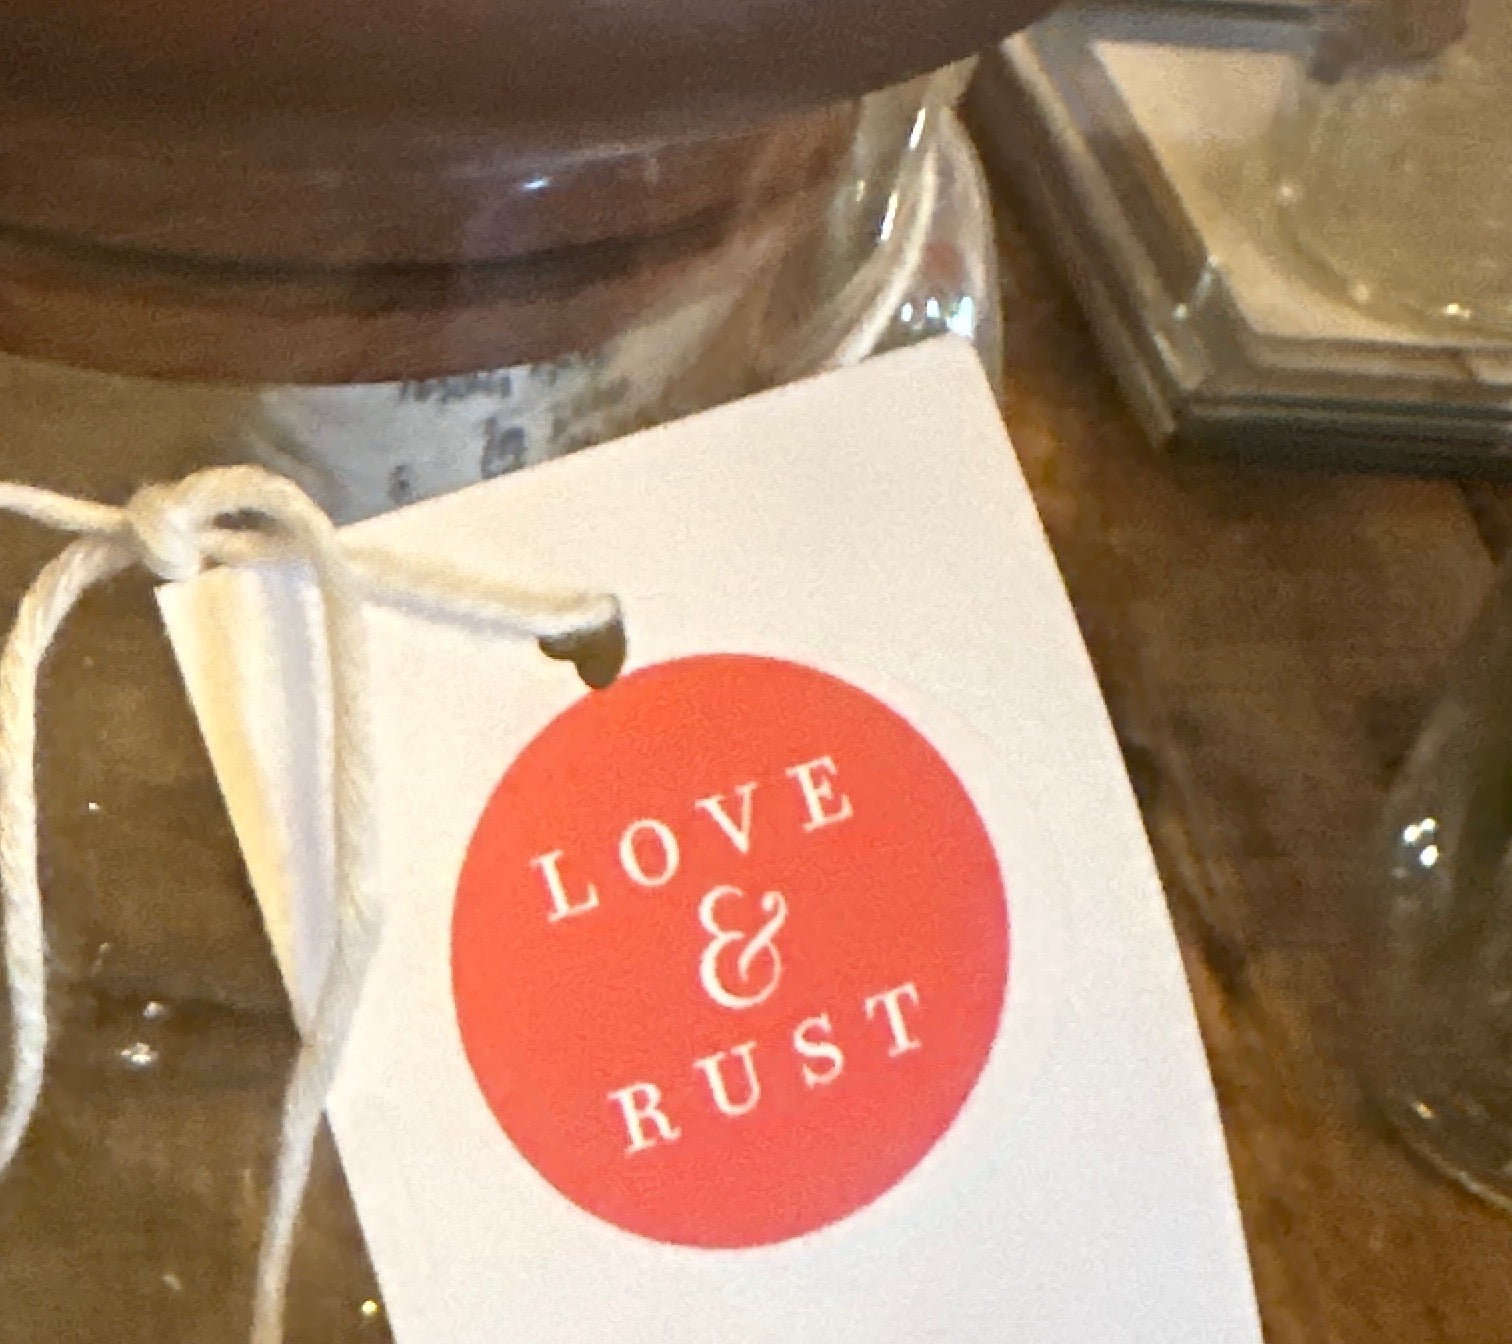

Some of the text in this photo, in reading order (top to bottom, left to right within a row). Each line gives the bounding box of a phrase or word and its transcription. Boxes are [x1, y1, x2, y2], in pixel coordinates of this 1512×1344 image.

[530, 755, 854, 923] LOVE
[698, 884, 789, 1009] &
[607, 981, 922, 1156] RUST
